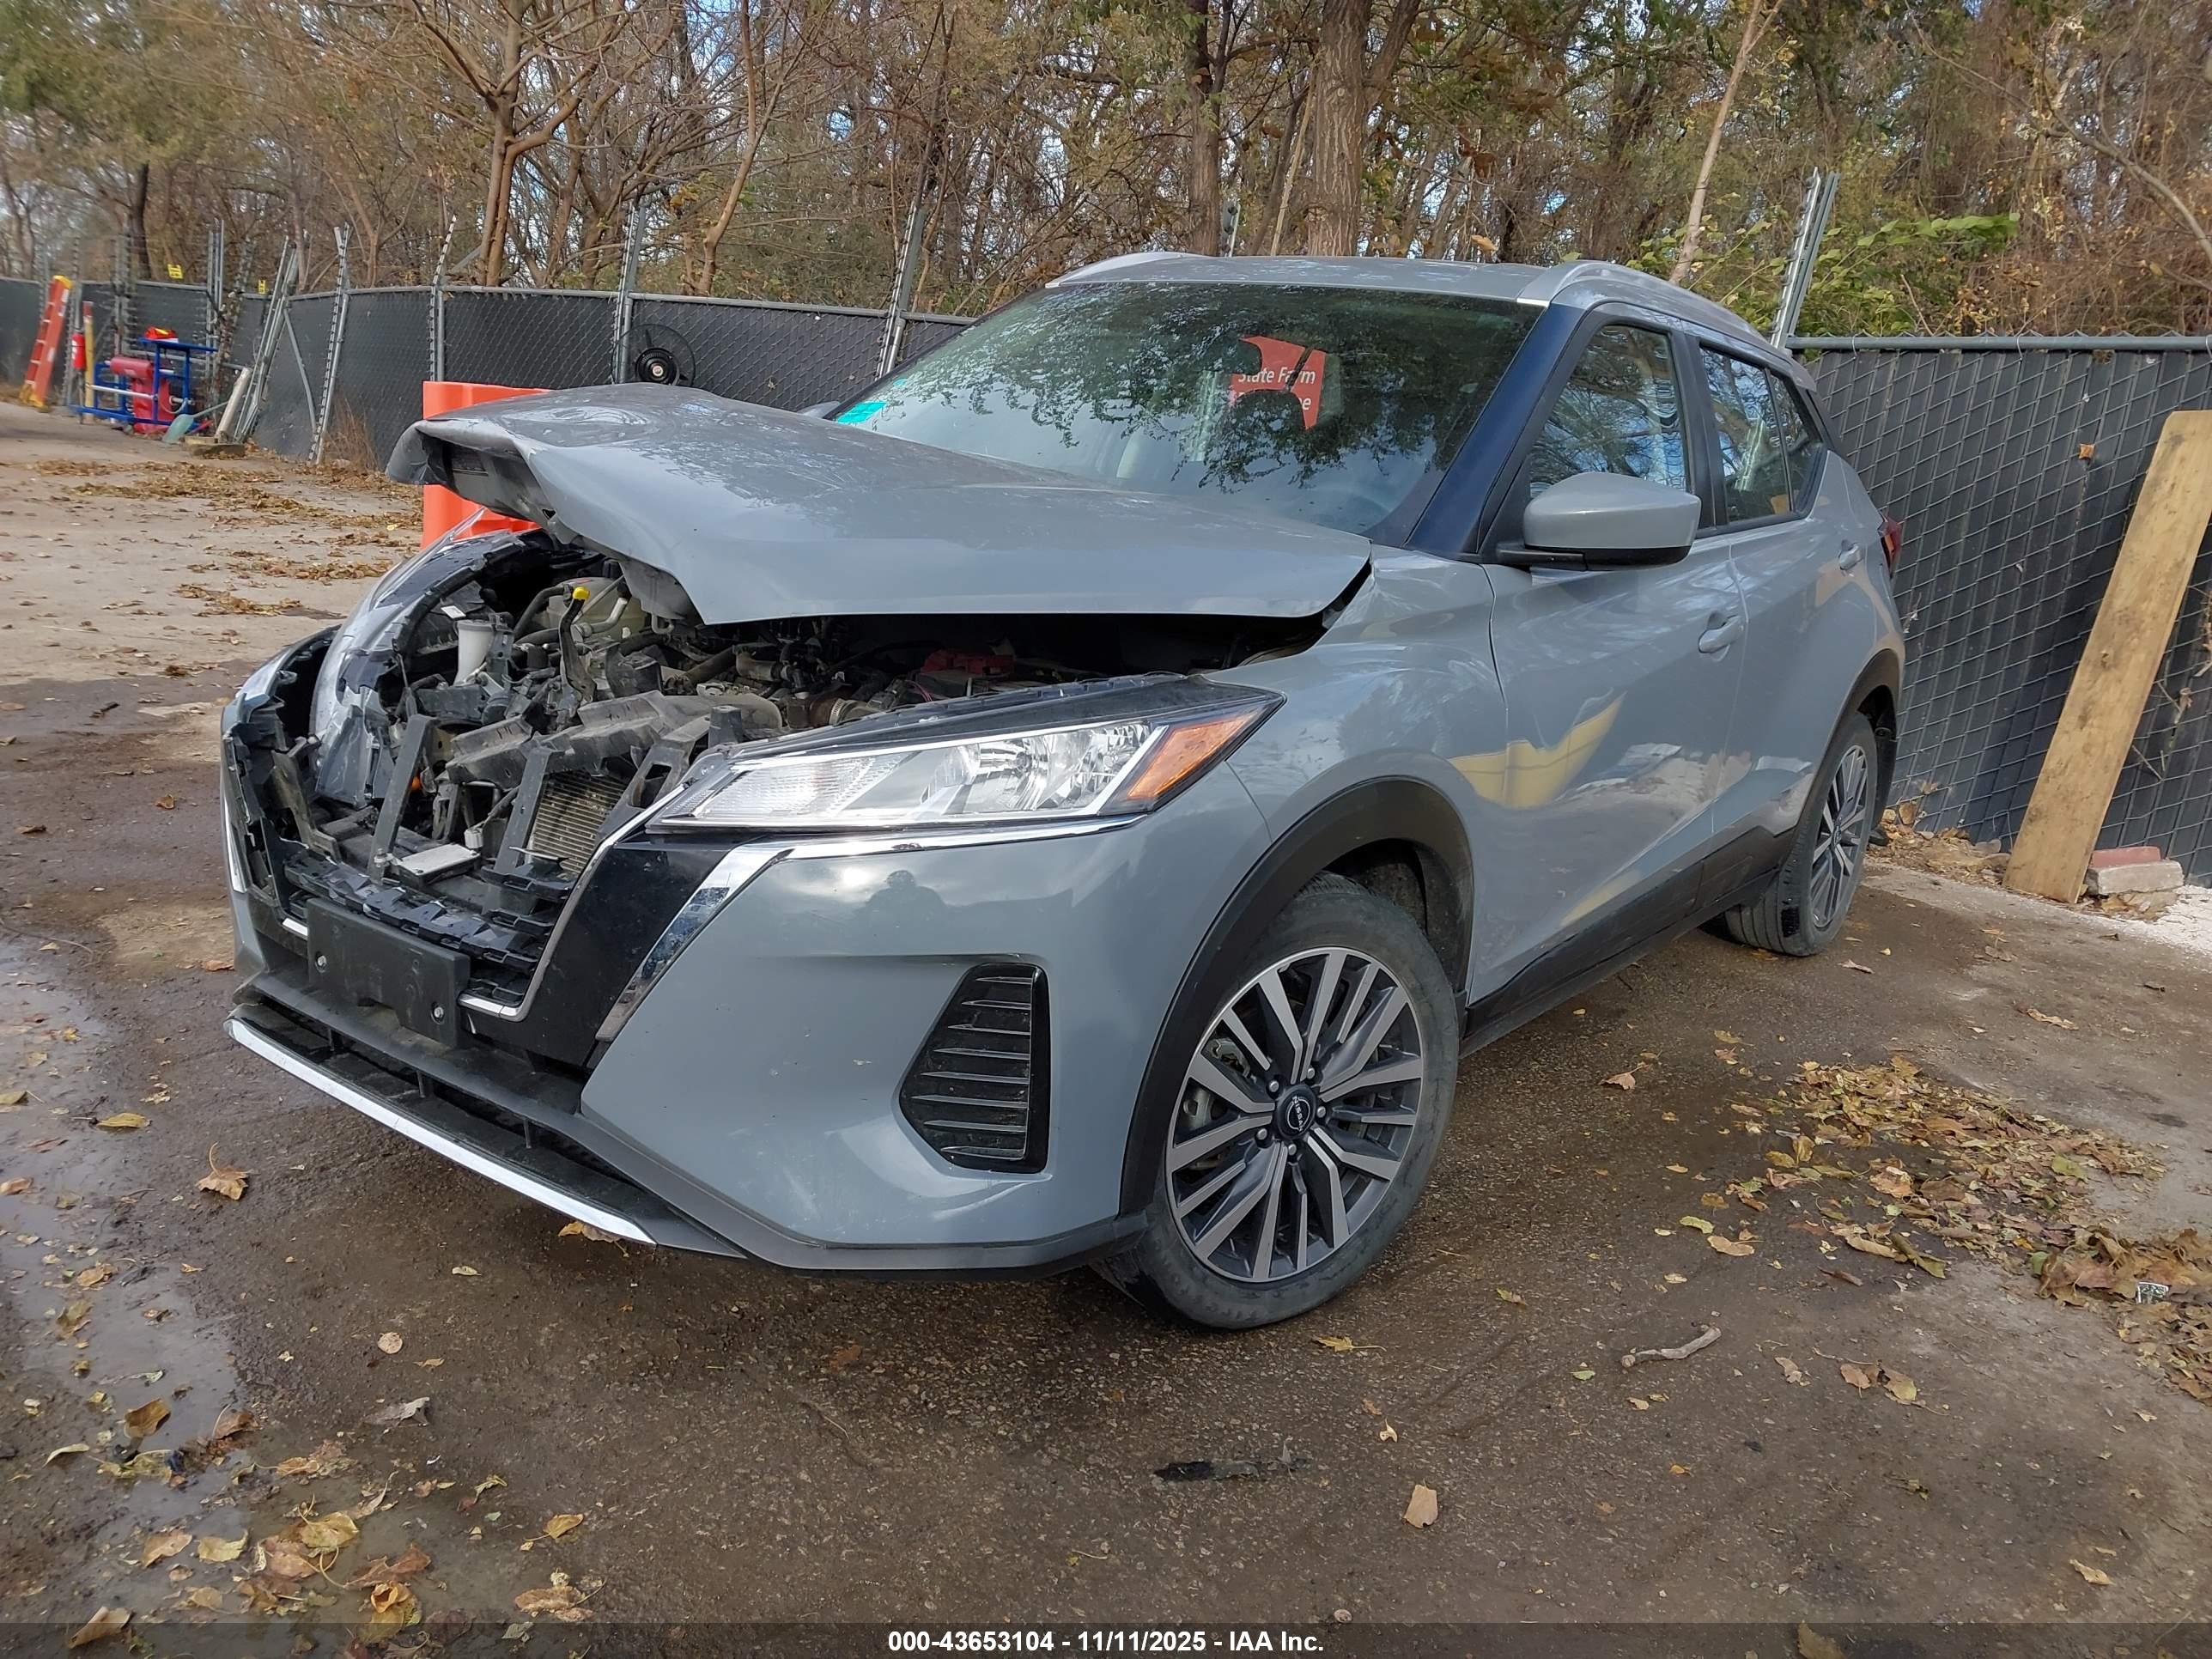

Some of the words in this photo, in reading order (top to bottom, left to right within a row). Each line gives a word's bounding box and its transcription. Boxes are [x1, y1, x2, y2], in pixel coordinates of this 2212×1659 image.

[1238, 368, 1274, 383] State
[1278, 367, 1316, 384] Fam
[1292, 1096, 1304, 1132] NISSAN
